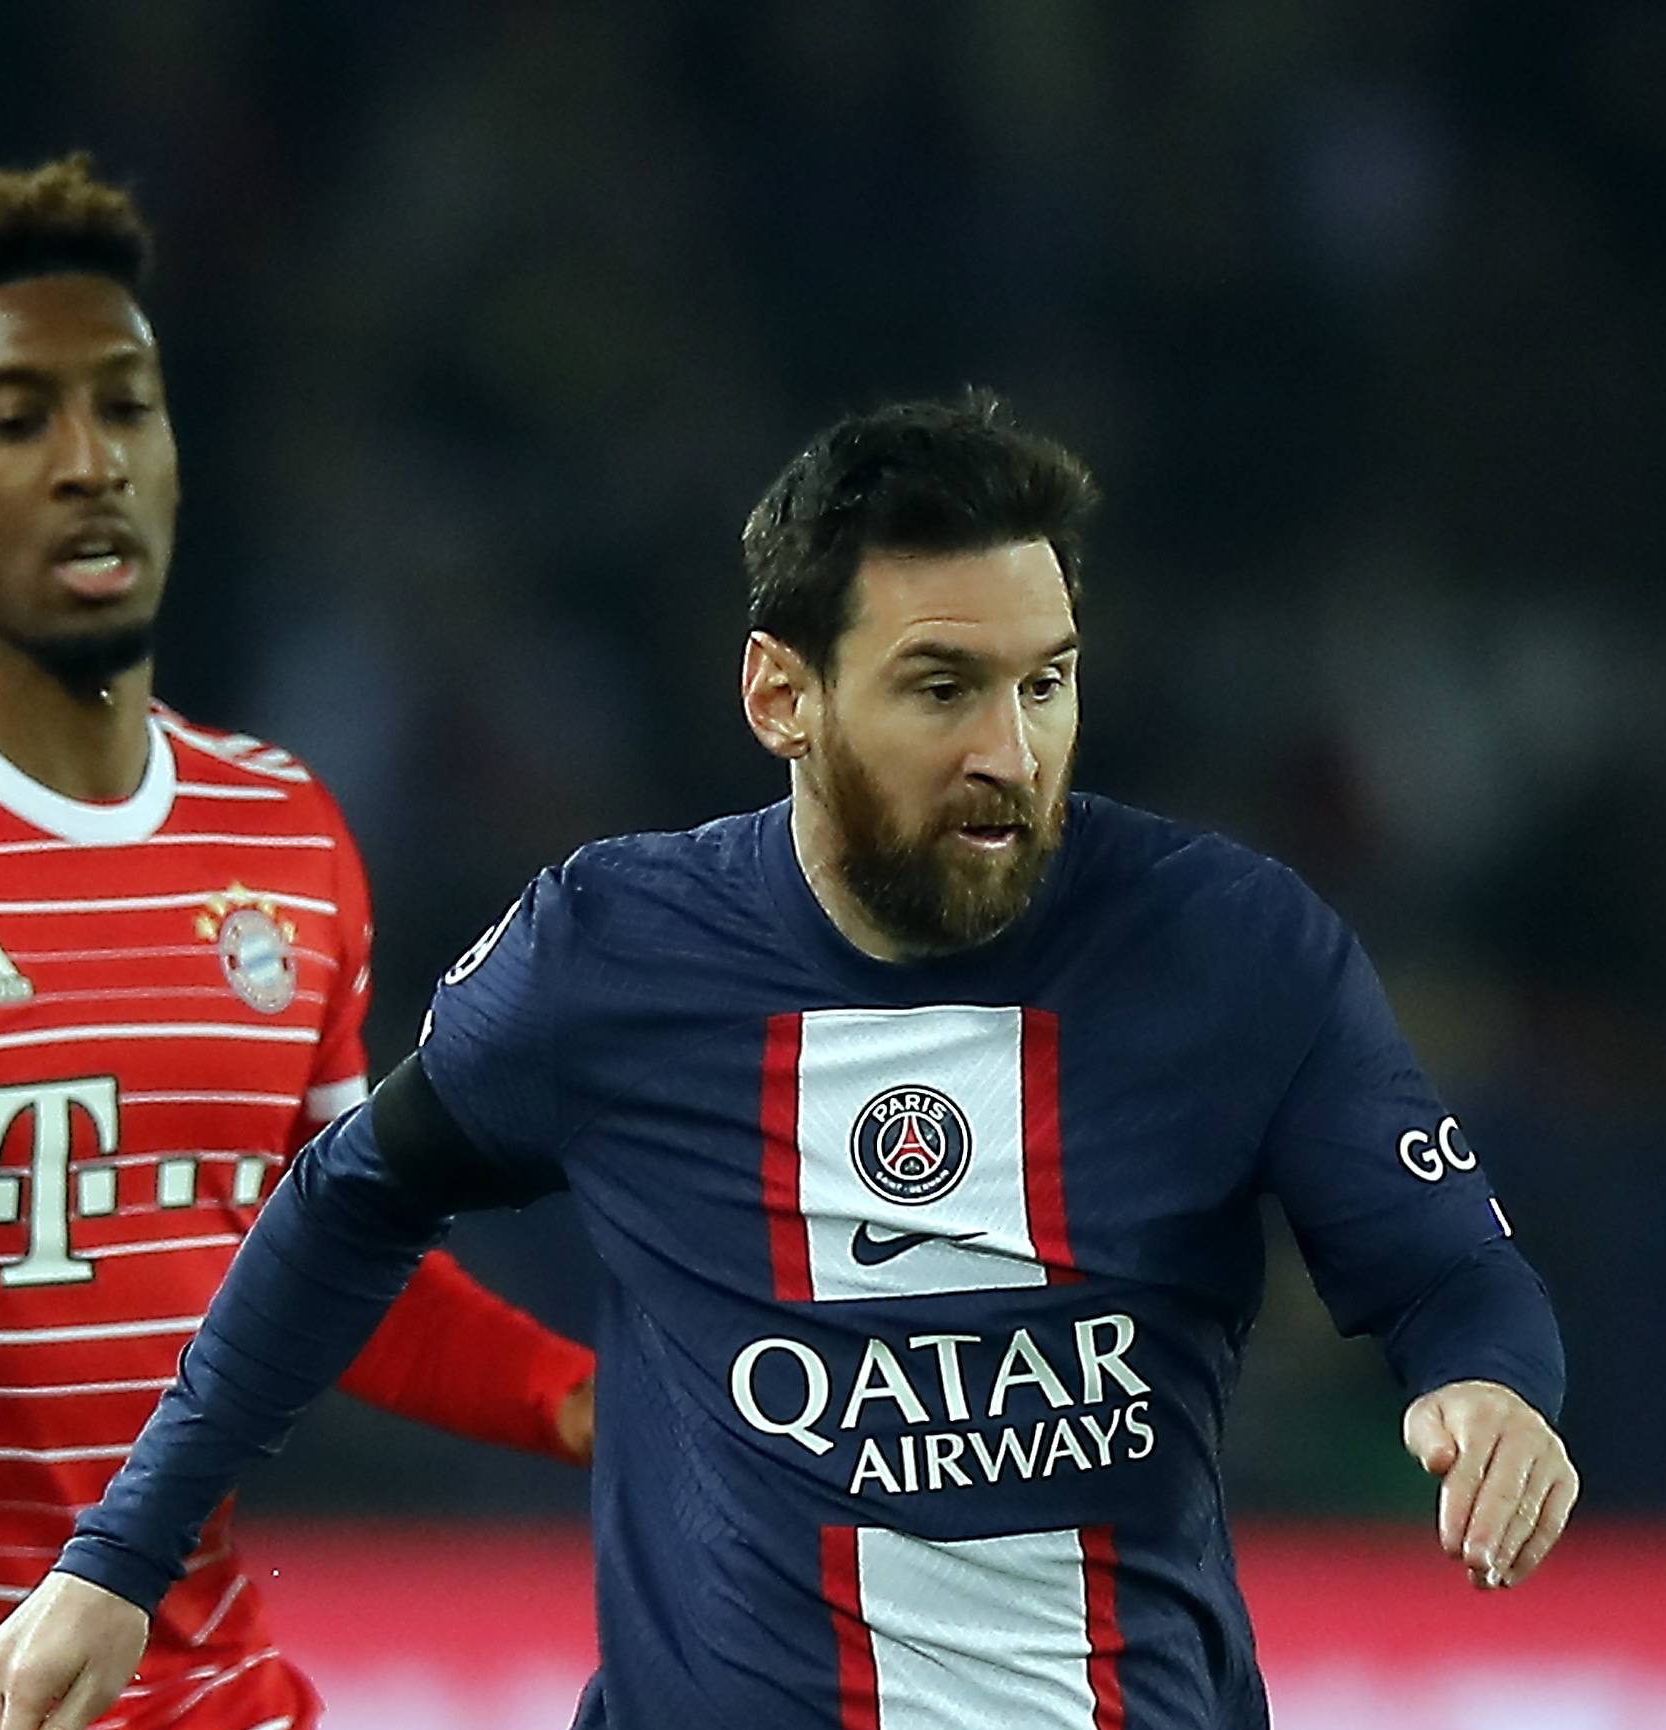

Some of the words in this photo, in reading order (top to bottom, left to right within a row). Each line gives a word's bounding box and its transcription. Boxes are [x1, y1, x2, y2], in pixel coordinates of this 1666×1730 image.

[872, 1093, 948, 1123] PARIS
[731, 1313, 1152, 1456] QATAR
[849, 1401, 1156, 1495] AIRWAYS
